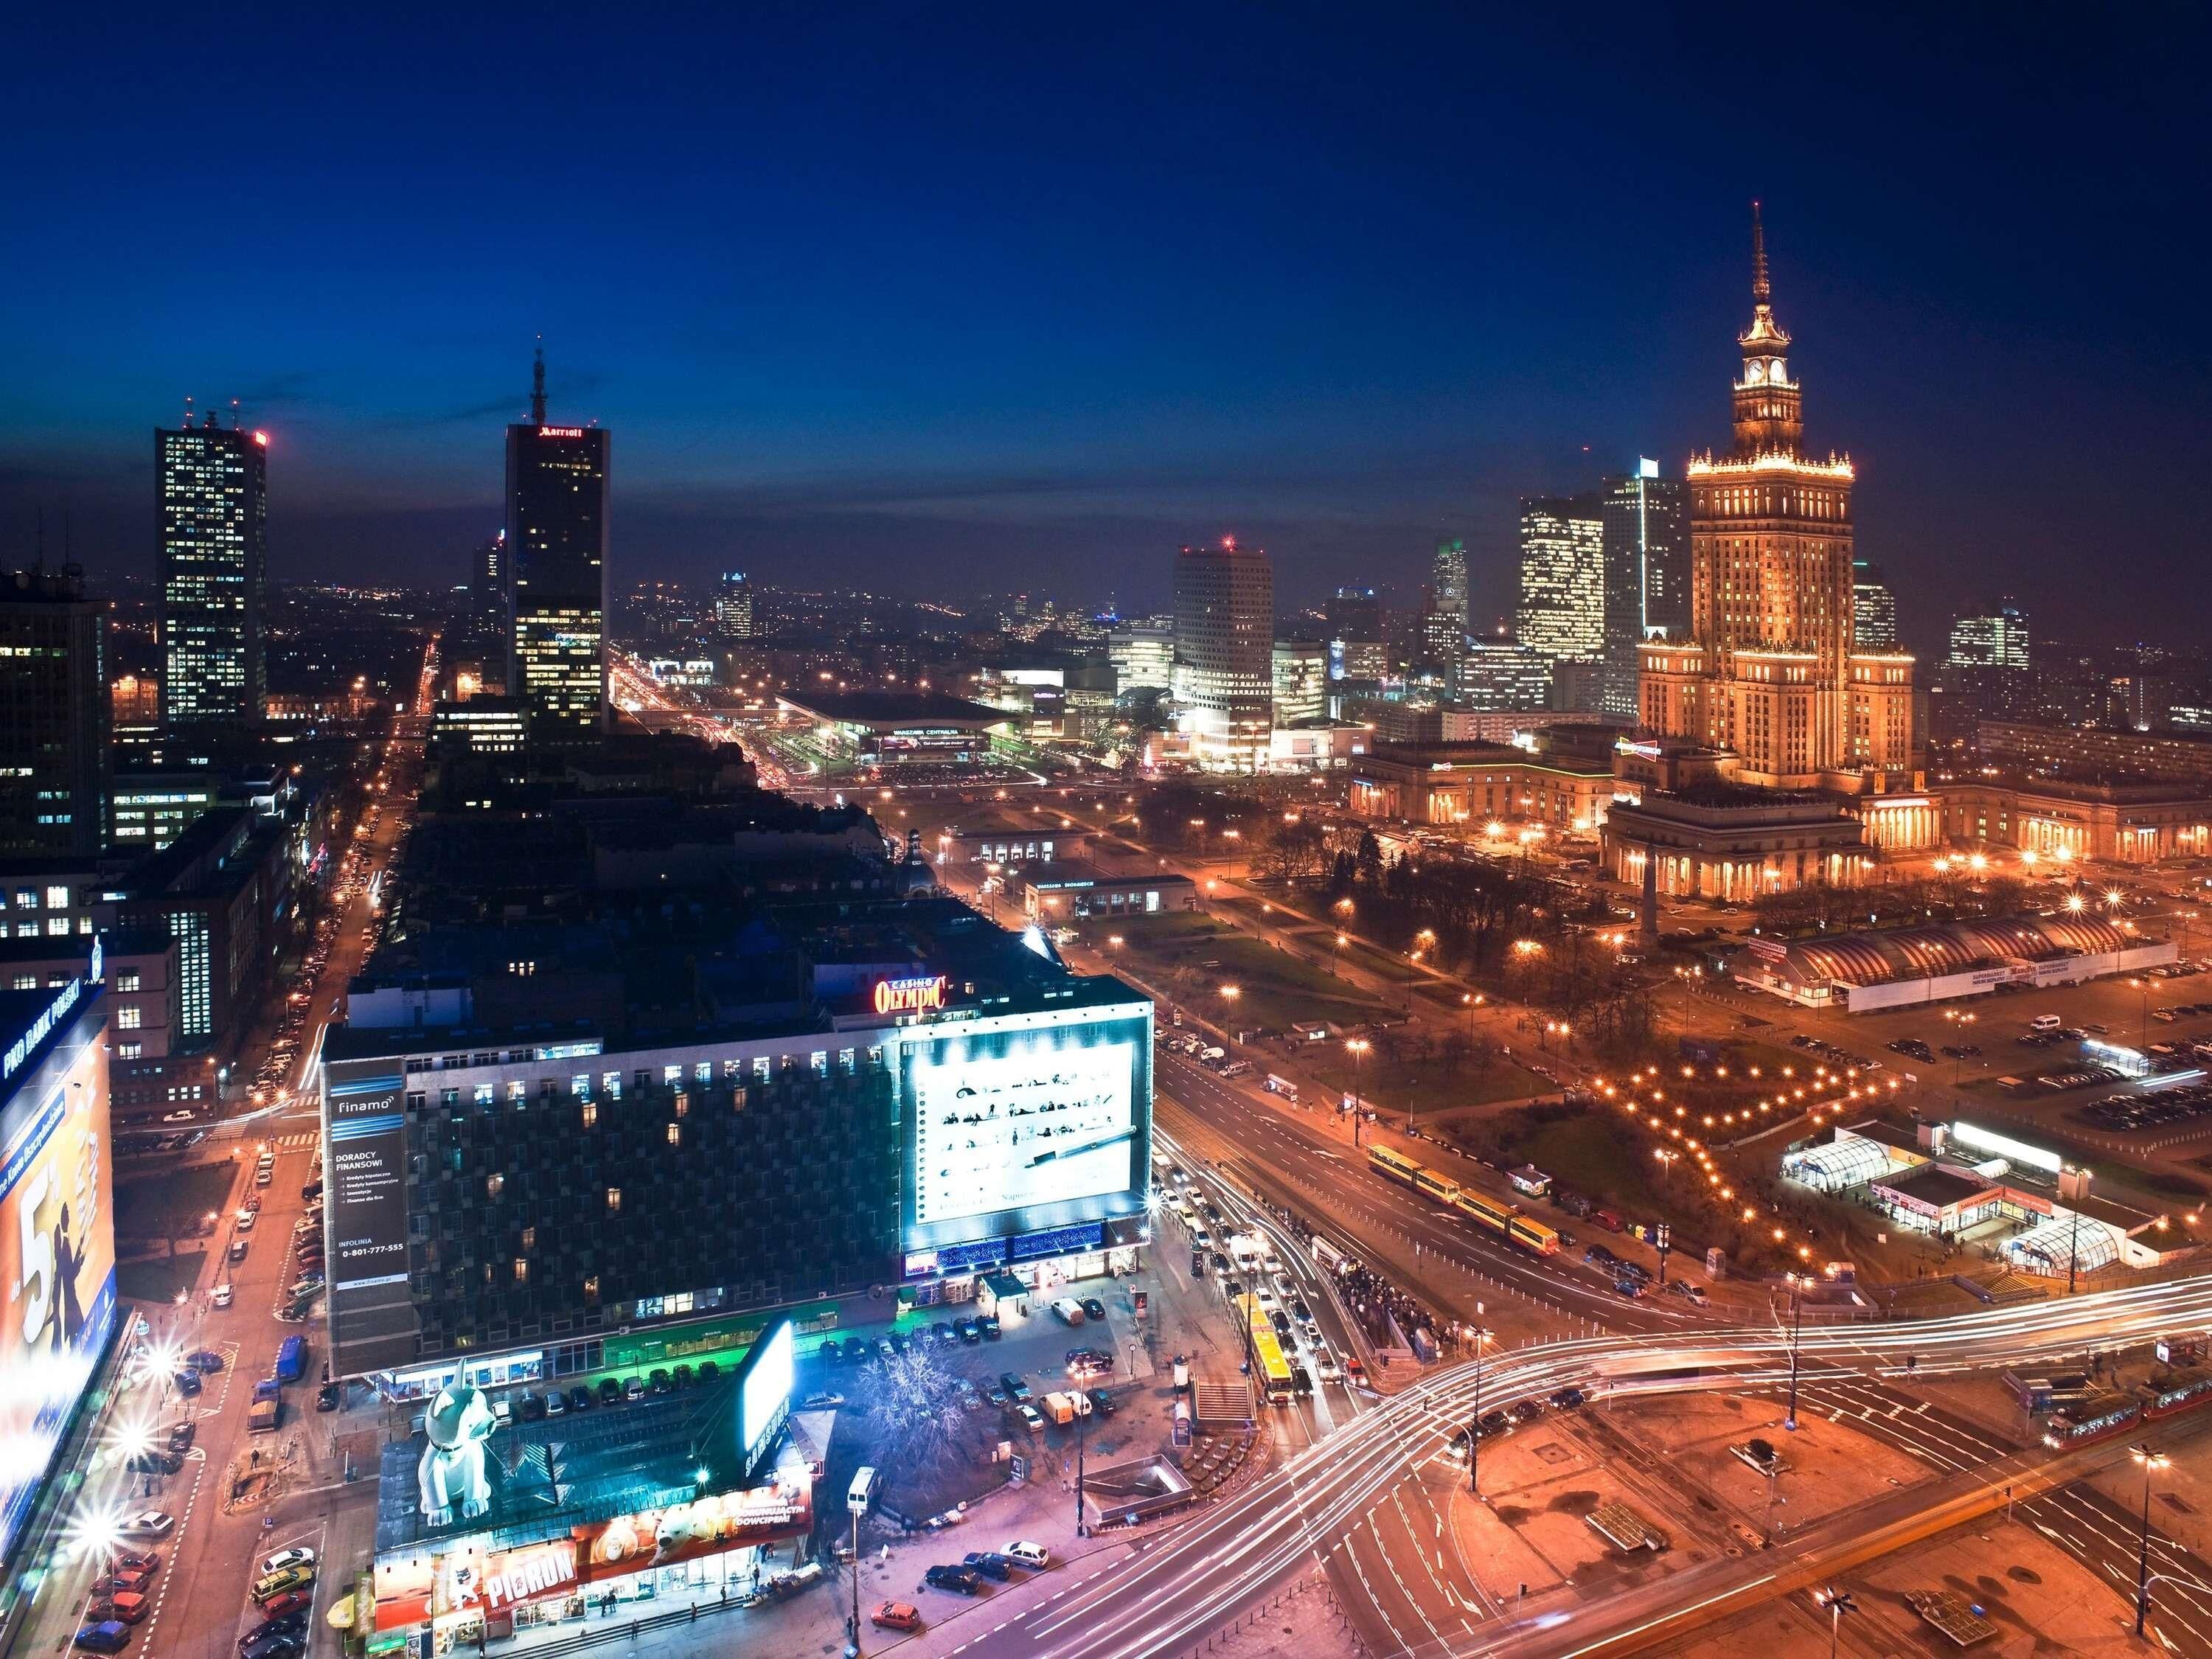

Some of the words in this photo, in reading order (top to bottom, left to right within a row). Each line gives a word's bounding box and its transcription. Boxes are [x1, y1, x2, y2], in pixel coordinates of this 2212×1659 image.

[891, 978, 933, 988] CASINO
[4, 1038, 24, 1079] PKO
[25, 1008, 52, 1055] BANK
[52, 977, 80, 1026] POLSKI
[339, 1101, 389, 1113] finamo
[335, 1151, 377, 1163] DORADCY
[336, 1159, 383, 1172] FINANSOWI
[338, 1238, 372, 1248] INFOLINIA
[342, 1243, 404, 1258] 0-801-777-555
[354, 1277, 392, 1287] www.finamo.pl
[745, 1397, 790, 1478] SAMSUNG
[736, 1514, 790, 1526] DOWCIPEM!
[486, 1551, 574, 1609] PIORUN
